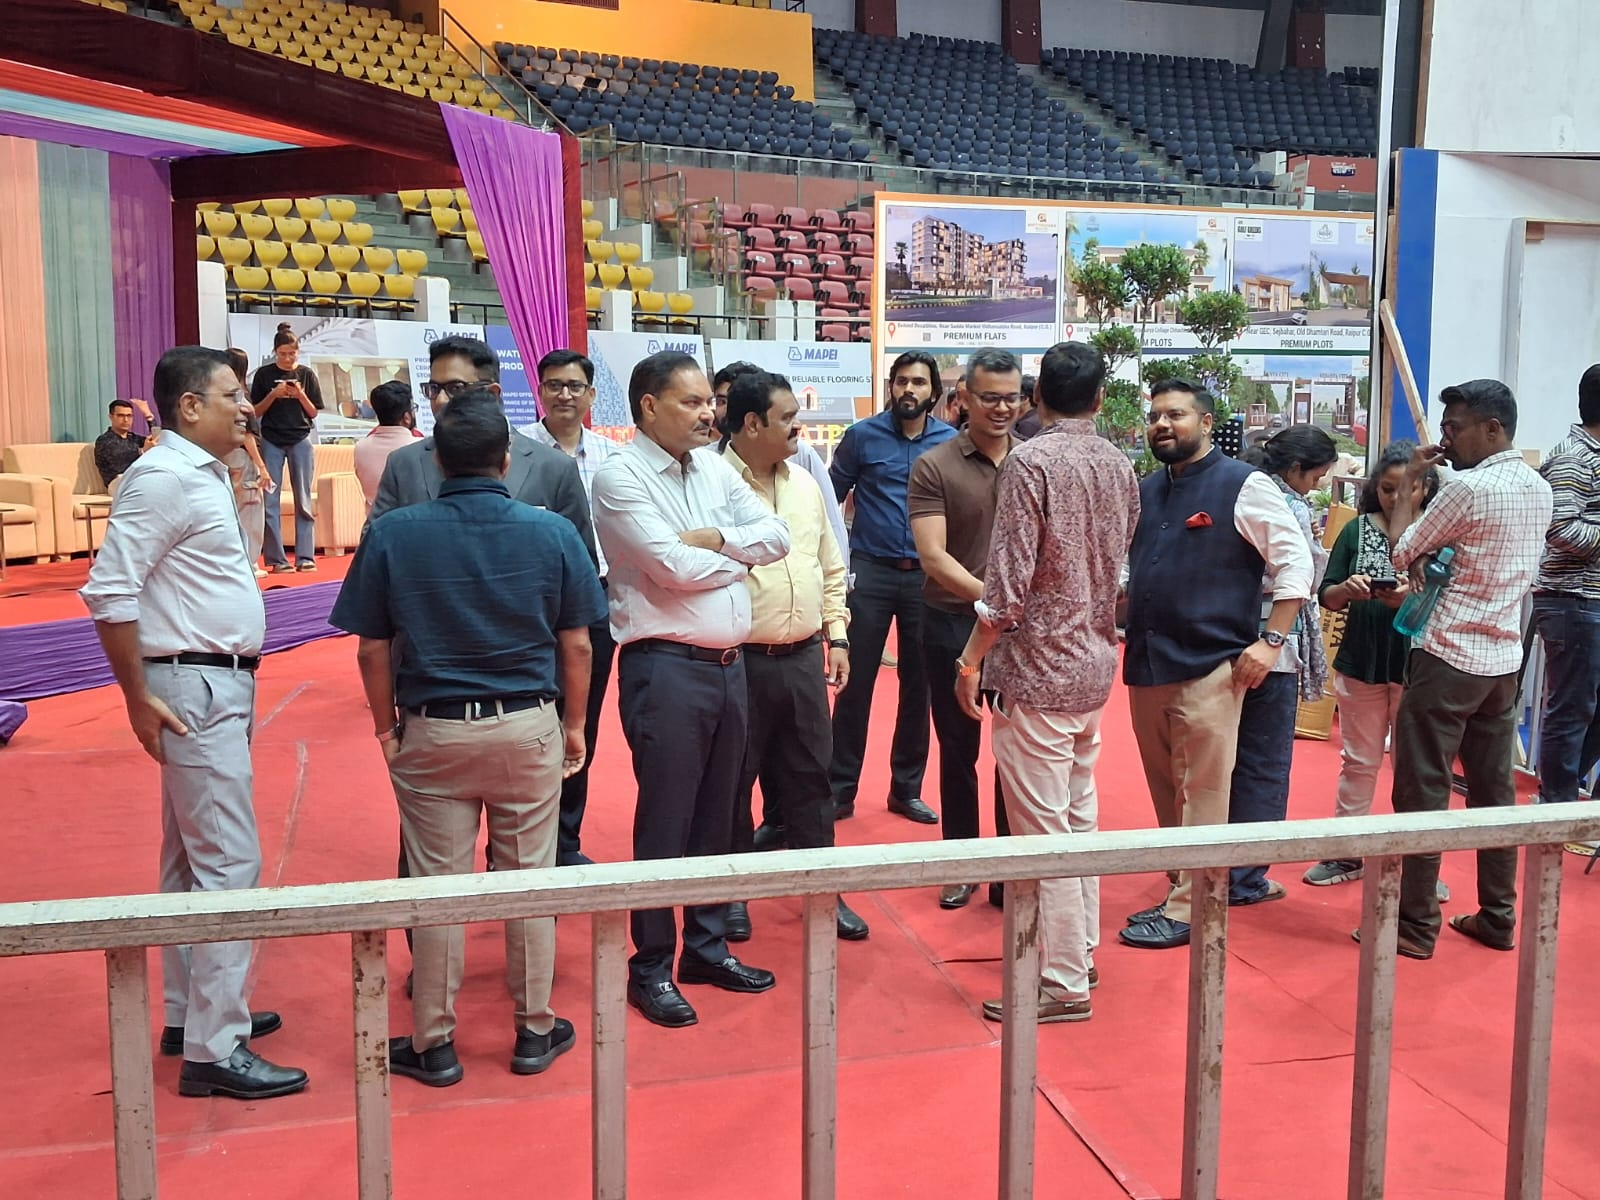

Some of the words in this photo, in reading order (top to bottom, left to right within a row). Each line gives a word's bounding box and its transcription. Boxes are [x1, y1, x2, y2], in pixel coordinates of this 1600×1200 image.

[943, 332, 983, 340] PREMIUM
[984, 332, 1007, 340] FLATS
[1150, 338, 1173, 347] PLOTS
[1280, 340, 1312, 348] PREMIUM
[1313, 340, 1334, 348] PLOTS
[804, 348, 838, 361] MAPEI
[792, 375, 826, 383] RELIABLE
